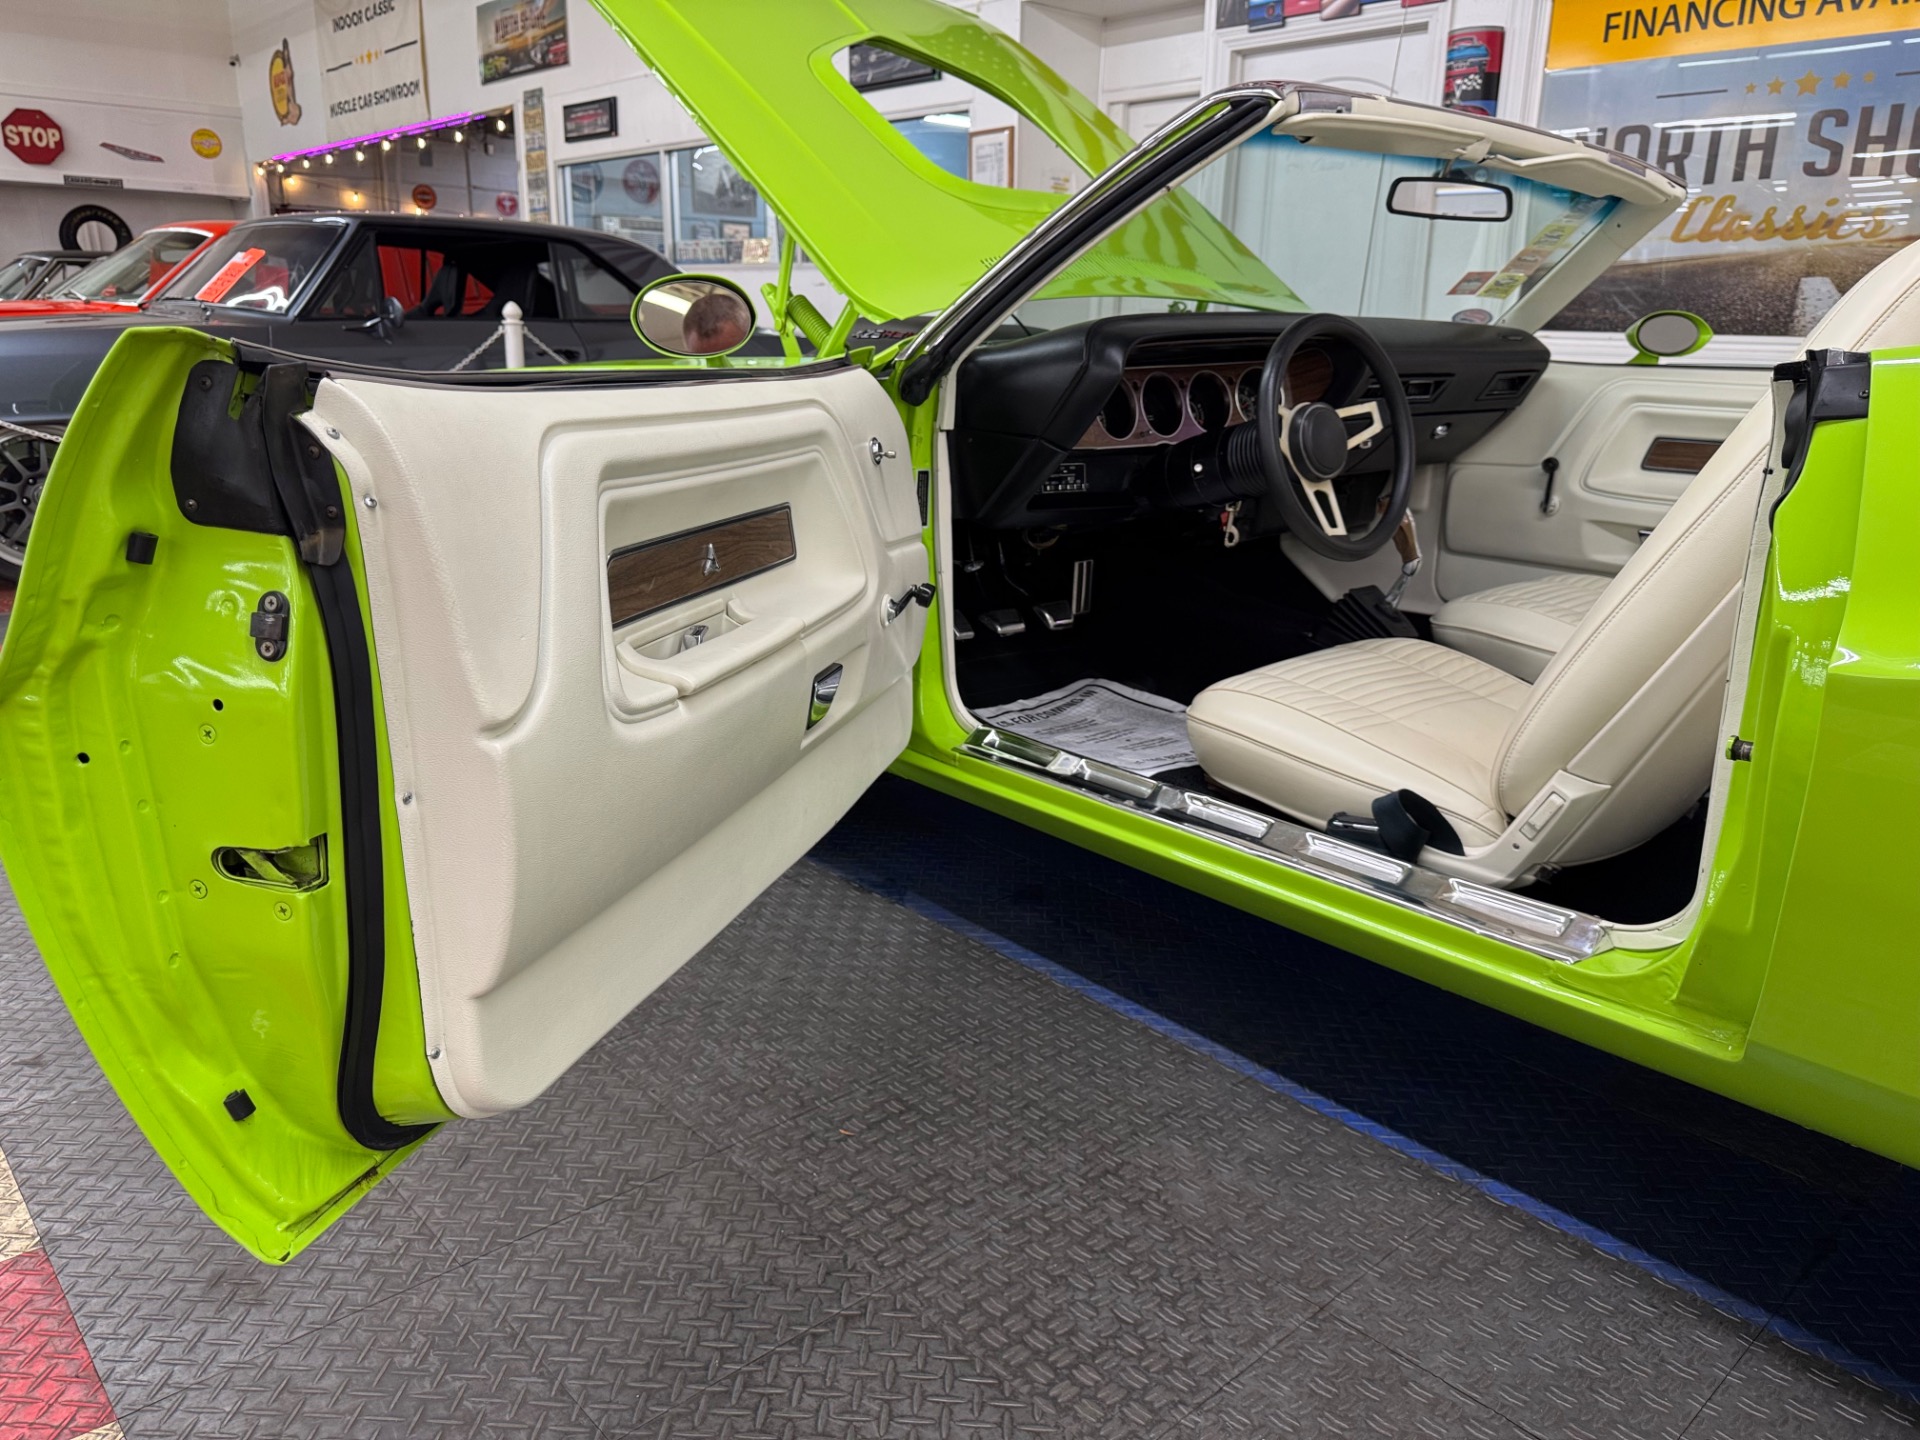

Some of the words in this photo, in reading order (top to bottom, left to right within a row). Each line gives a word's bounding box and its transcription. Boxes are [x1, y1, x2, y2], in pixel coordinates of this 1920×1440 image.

[332, 9, 364, 33] INDOOR
[364, 0, 396, 22] CLASSIC
[1603, 0, 1806, 43] FINANCING
[329, 97, 358, 118] MUSCLE
[357, 92, 374, 111] CAR
[373, 79, 421, 106] SHOWROOM
[4, 124, 61, 150] STOP
[1670, 194, 1895, 243] Classics
[1010, 714, 1040, 725] FOR
